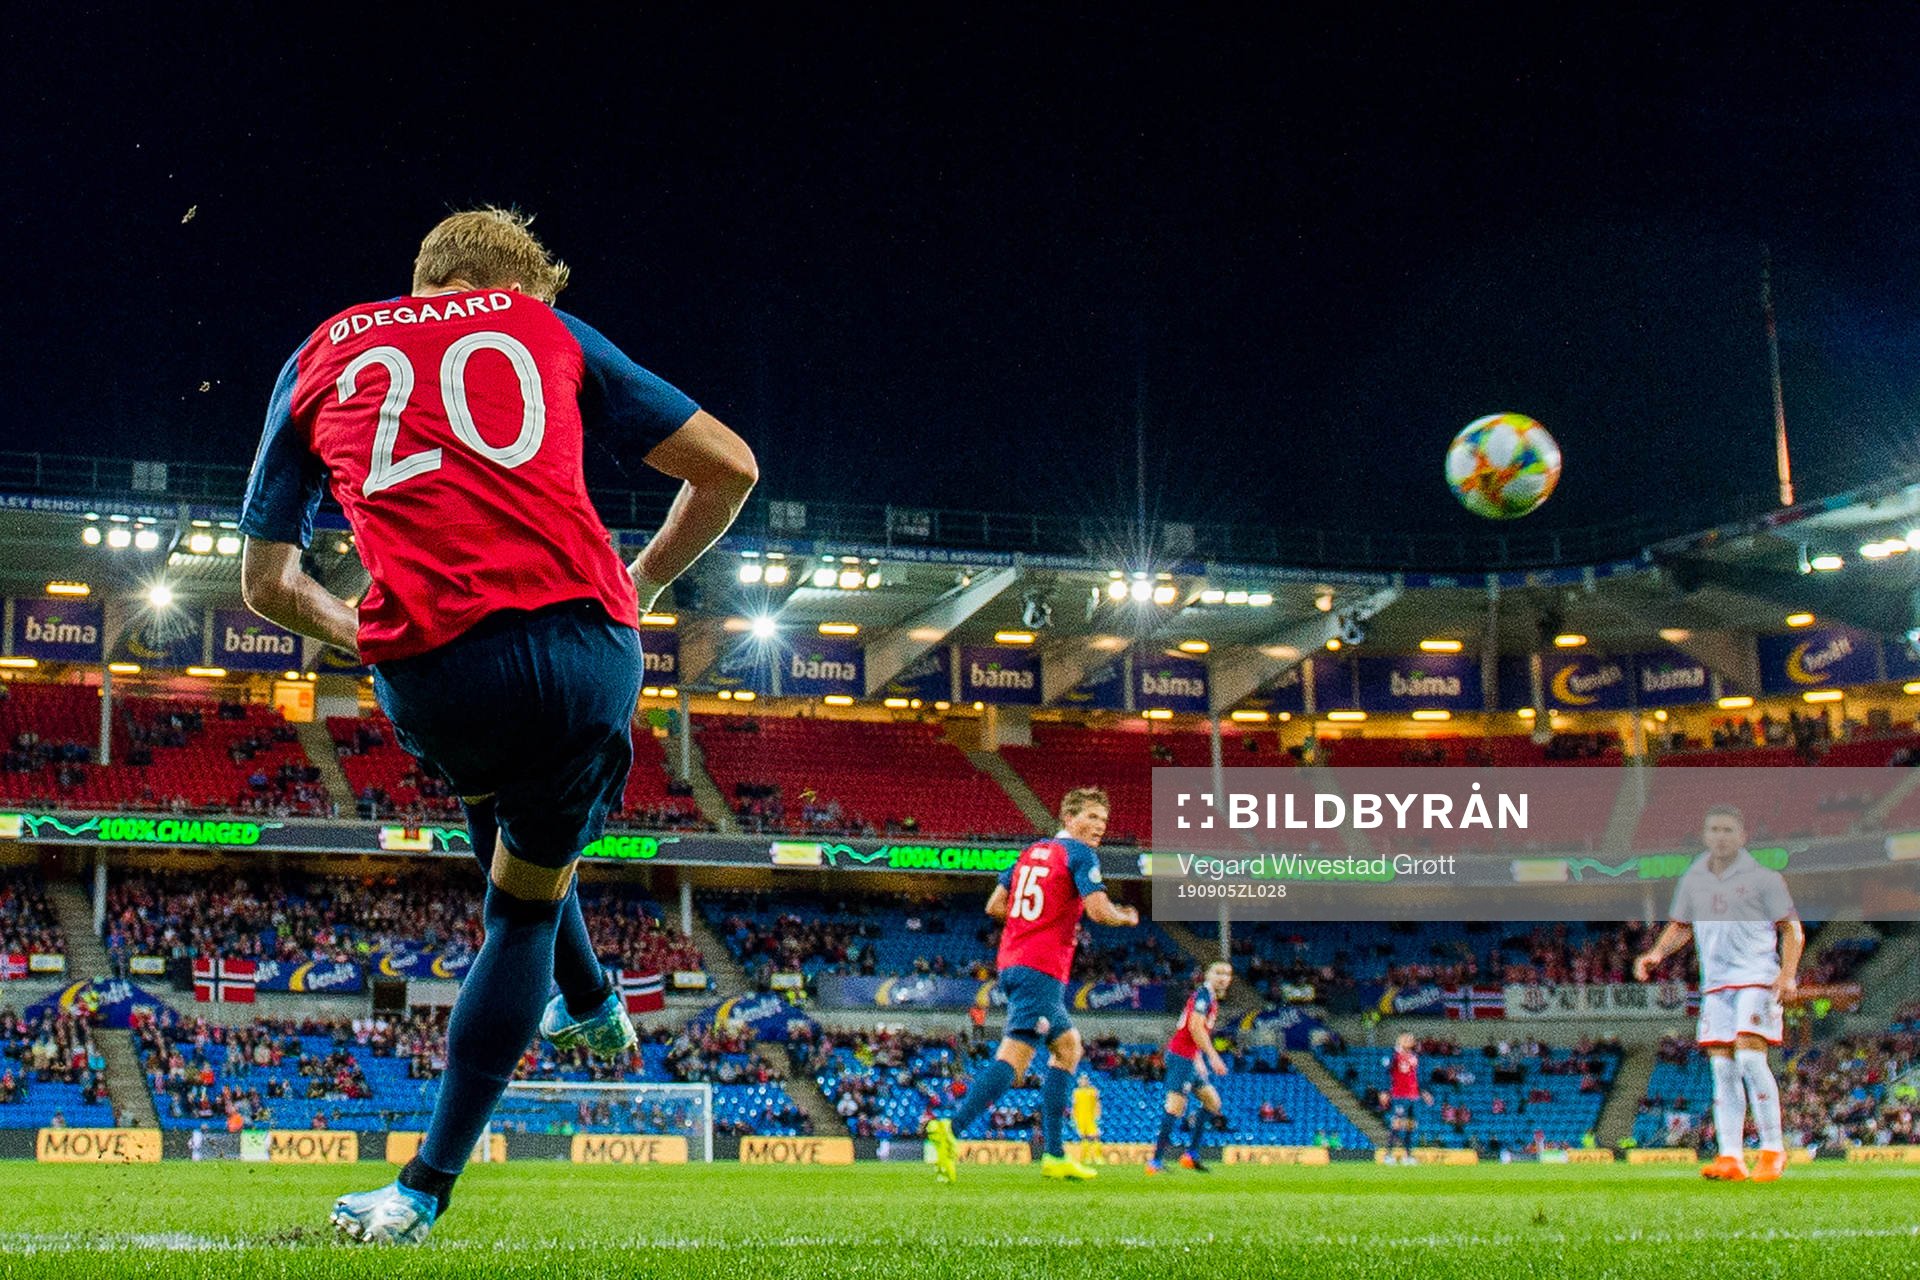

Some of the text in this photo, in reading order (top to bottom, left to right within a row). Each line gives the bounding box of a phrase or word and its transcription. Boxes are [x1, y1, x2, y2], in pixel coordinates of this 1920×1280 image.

[329, 292, 512, 344] ØDEGAARD
[336, 331, 546, 499] 20
[25, 616, 96, 644] bama
[225, 628, 294, 654] bama
[644, 653, 674, 672] ma
[791, 655, 856, 680] bama
[970, 662, 1034, 688] bama
[1142, 671, 1204, 696] bama
[1391, 671, 1461, 697] bama
[98, 818, 260, 844] 100% CHARGED
[582, 836, 658, 859] ARGED
[889, 846, 940, 869] 100%
[941, 848, 1020, 870] CHARGE
[1010, 865, 1050, 921] 15
[308, 963, 354, 990] Bendit
[44, 1133, 128, 1157] MOVE
[269, 1135, 350, 1159] MOVE
[583, 1139, 662, 1162] MOVE
[746, 1140, 823, 1163] MOVE
